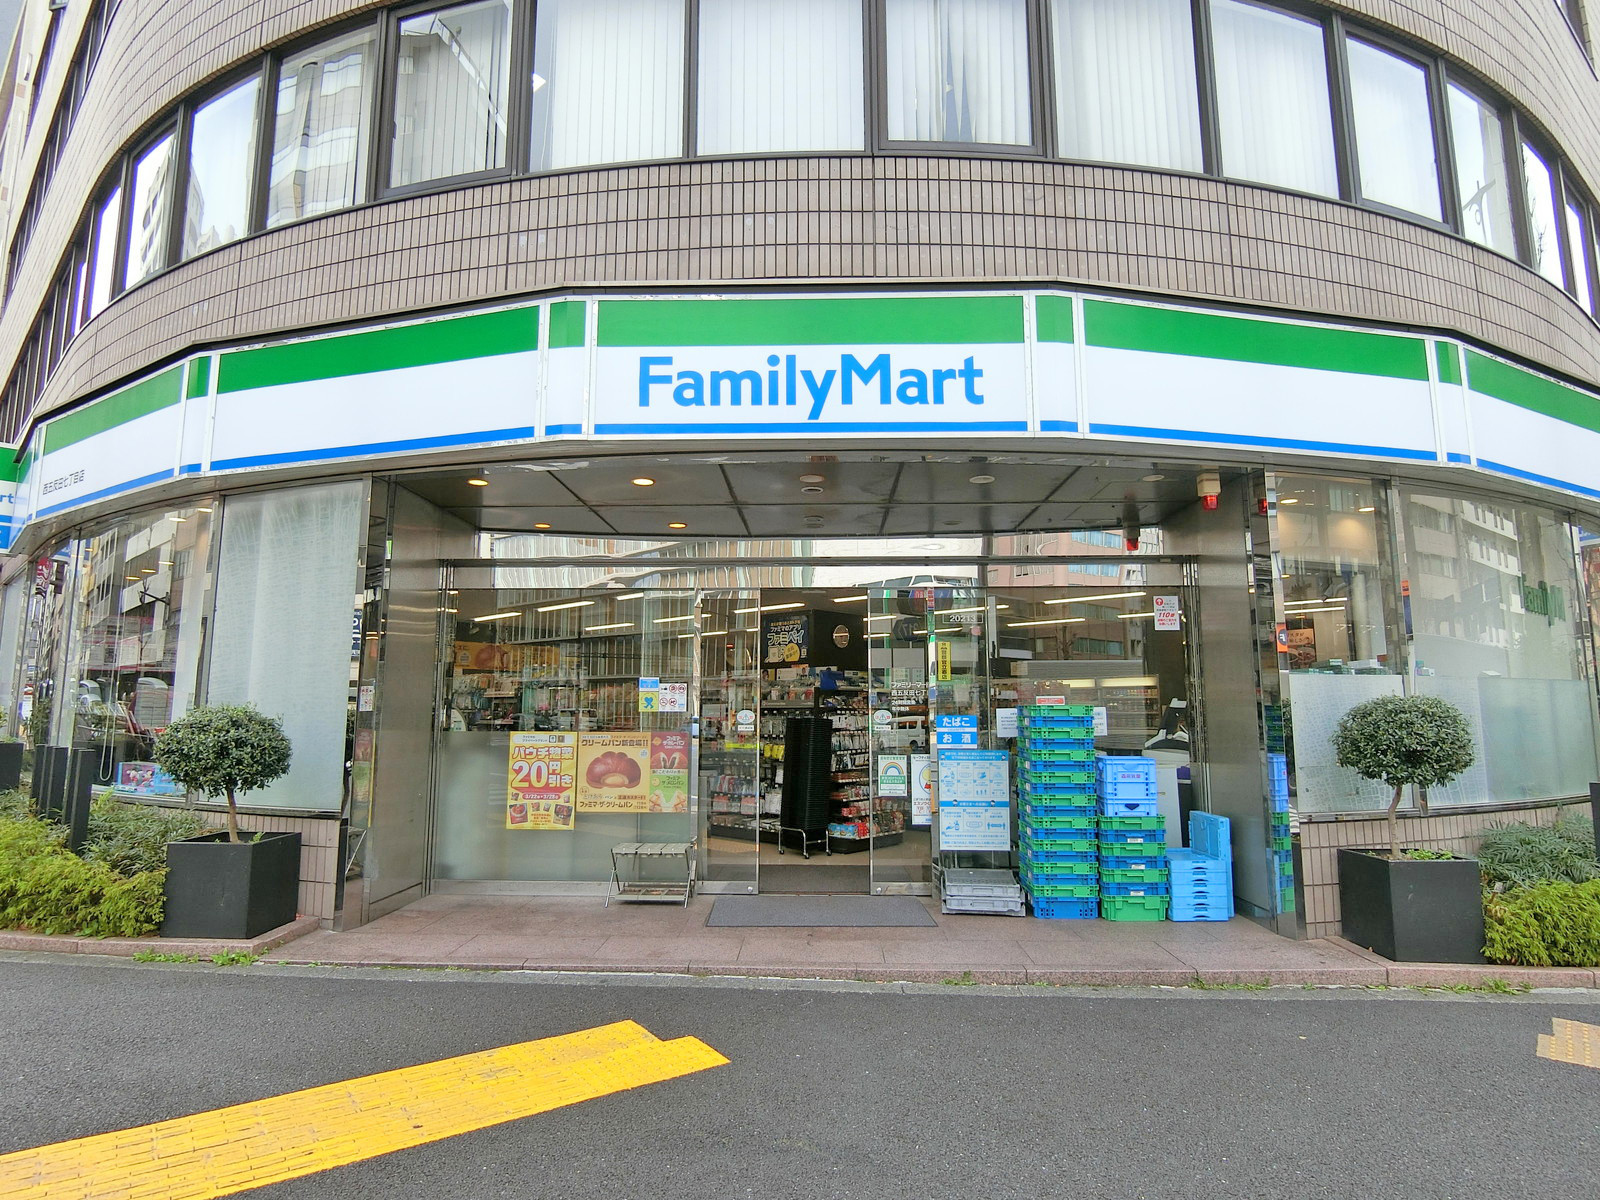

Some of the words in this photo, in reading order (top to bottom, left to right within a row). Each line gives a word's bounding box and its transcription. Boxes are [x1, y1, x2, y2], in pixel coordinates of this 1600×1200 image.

[638, 353, 984, 421] FamilyMart
[767, 630, 805, 646] ファミペイ
[942, 717, 971, 727] たばこ
[511, 745, 574, 760] パウチ惣菜
